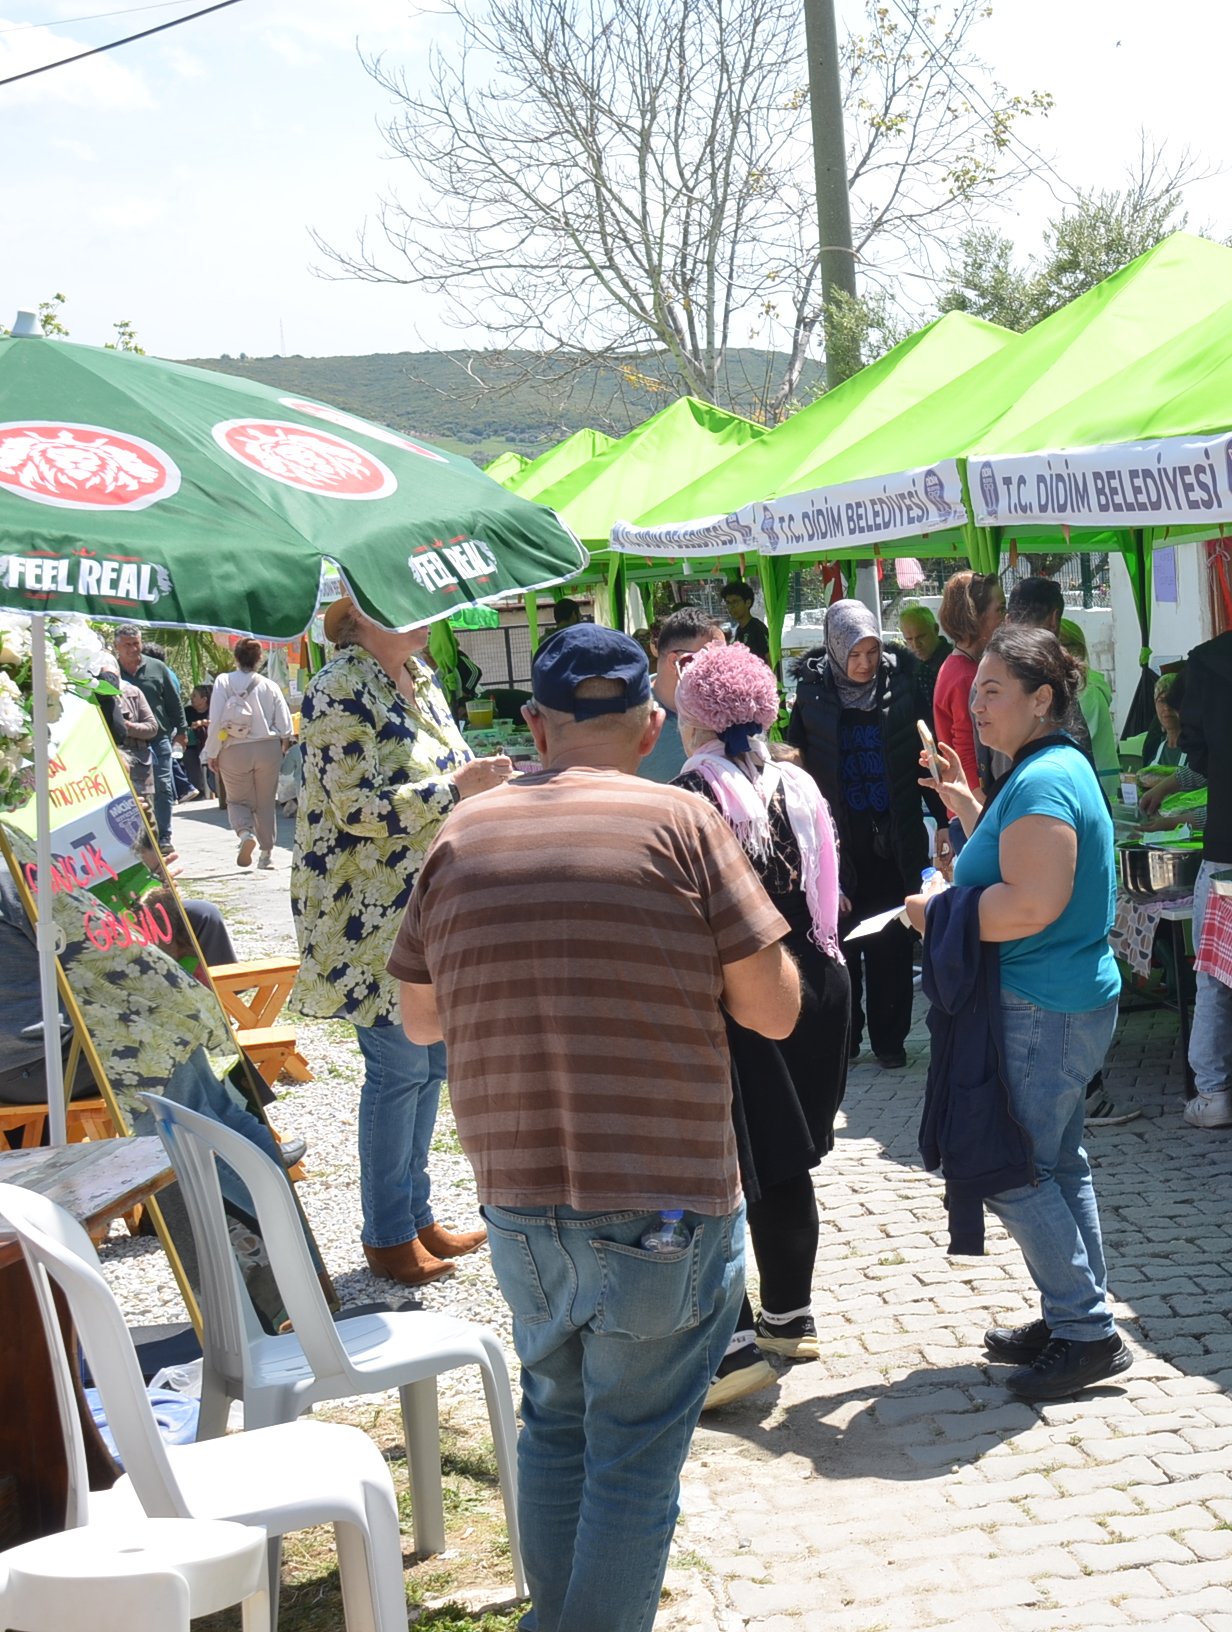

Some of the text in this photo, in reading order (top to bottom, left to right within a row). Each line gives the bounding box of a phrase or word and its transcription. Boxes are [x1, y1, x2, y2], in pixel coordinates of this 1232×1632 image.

[778, 478, 929, 545] T.C. DİDİM BELEDİYESİ
[1003, 448, 1222, 514] T.C. DİDİM BELEDİYESİ
[8, 555, 157, 601] FEEL REAL
